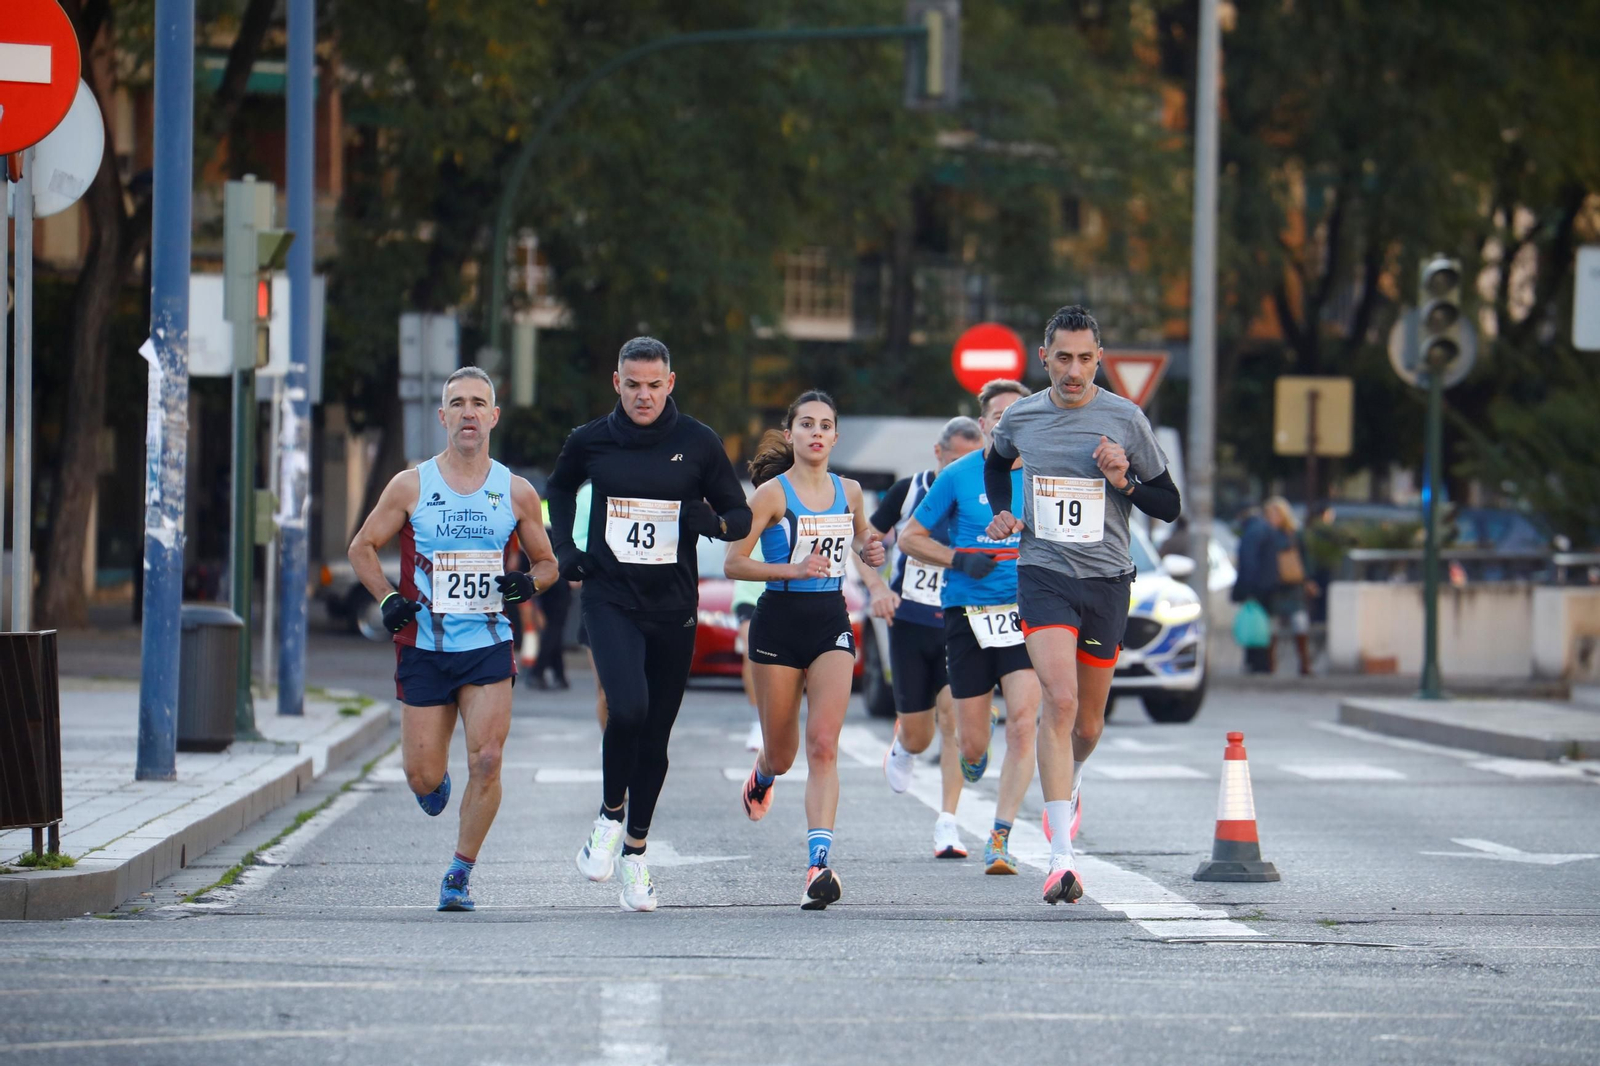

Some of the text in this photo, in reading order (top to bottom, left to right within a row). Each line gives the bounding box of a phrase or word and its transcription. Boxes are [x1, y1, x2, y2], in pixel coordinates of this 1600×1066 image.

[1036, 478, 1056, 498] XLI
[438, 509, 487, 523] Triatlon
[610, 499, 631, 519] XLI
[1055, 500, 1082, 527] 19
[626, 522, 656, 549] 43
[800, 517, 818, 536] XLI
[810, 537, 845, 562] 185
[436, 553, 457, 571] XLI
[448, 573, 490, 599] 255
[915, 570, 939, 592] 24
[983, 611, 1022, 636] 128
